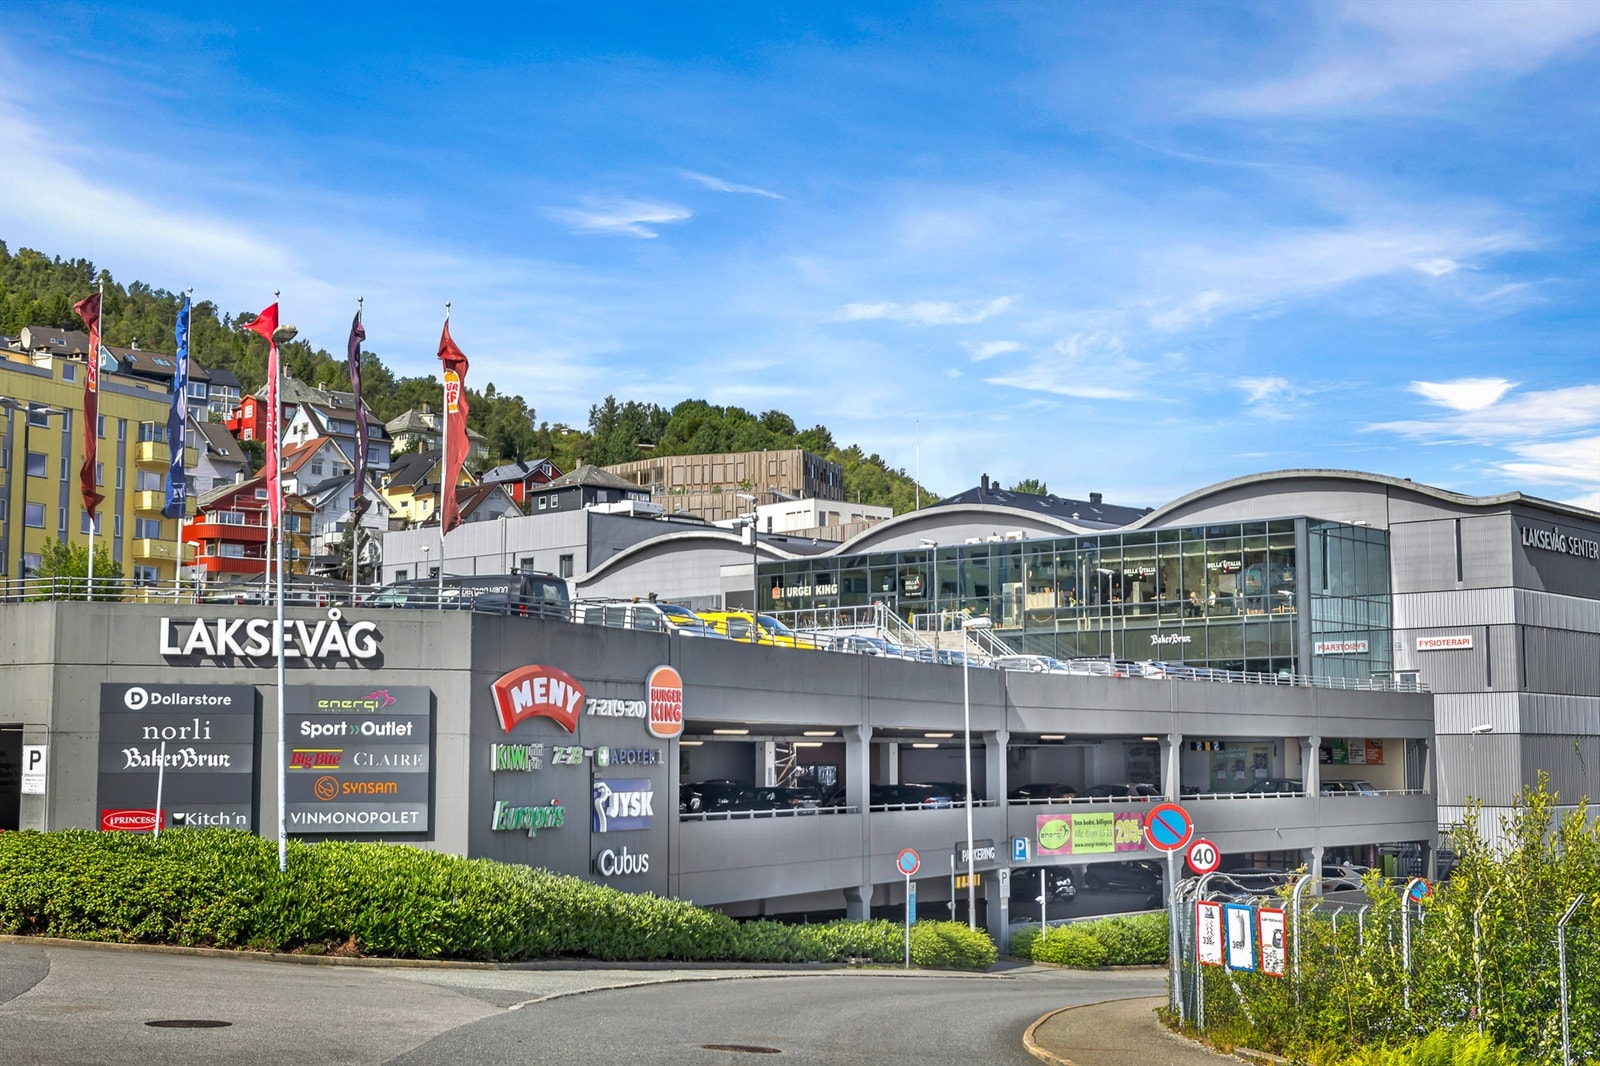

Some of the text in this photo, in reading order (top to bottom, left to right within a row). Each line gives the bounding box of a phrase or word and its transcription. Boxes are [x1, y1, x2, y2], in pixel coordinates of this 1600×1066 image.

[1523, 526, 1599, 560] LAKSEVÅG SENTER
[815, 584, 838, 596] KING
[160, 608, 377, 659] LAKSEVÅG
[1150, 633, 1191, 646] BakerBrun
[1419, 638, 1470, 648] FYSIOTERAPI
[150, 692, 232, 706] Dollarstore
[511, 677, 582, 714] MENY
[651, 688, 681, 703] BURGER
[318, 700, 379, 712] energi
[651, 702, 682, 722] KING
[142, 718, 212, 740] norli
[300, 721, 413, 738] Sport Outlet
[30, 750, 41, 770] P
[121, 747, 231, 770] BakerBrun
[290, 752, 343, 769] Big Bite
[353, 752, 423, 766] CLAIRE
[496, 744, 529, 771] KIWI
[611, 749, 655, 765] APOTEK
[342, 782, 398, 794] SYNSAM
[608, 791, 653, 818] JYSK
[114, 816, 156, 825] PRINCESS
[291, 811, 419, 825] VINMONOPOLET
[493, 799, 565, 837] Europris
[1116, 819, 1143, 845] 295,-
[962, 847, 995, 862] PAKERING
[1015, 839, 1025, 856] P
[1193, 848, 1214, 864] 40
[599, 846, 649, 877] Cubus
